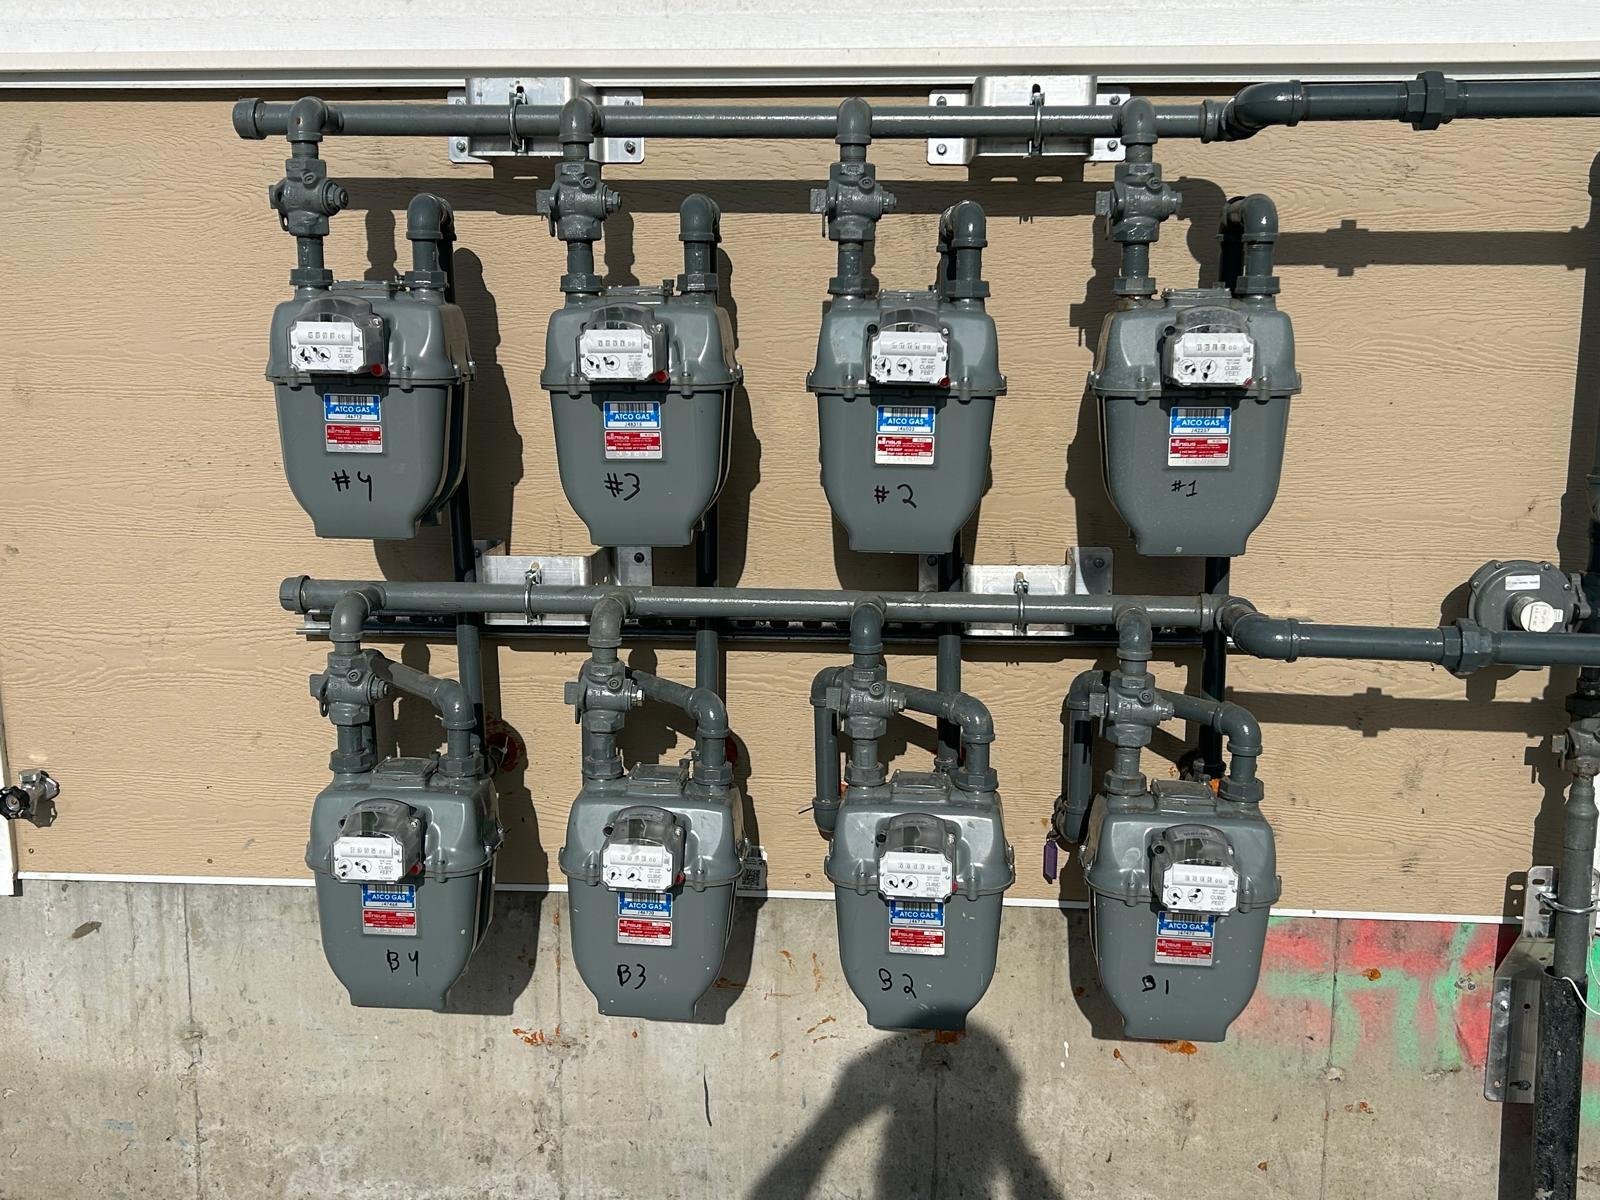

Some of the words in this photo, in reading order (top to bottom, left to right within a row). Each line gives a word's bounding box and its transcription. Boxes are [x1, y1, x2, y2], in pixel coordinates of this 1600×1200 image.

[604, 473, 640, 501] #3
[874, 484, 917, 509] #2
[1171, 480, 1198, 497] #1
[387, 949, 419, 977] B4
[617, 963, 647, 990] B3
[879, 968, 917, 999] B2
[1142, 975, 1169, 995] B1
